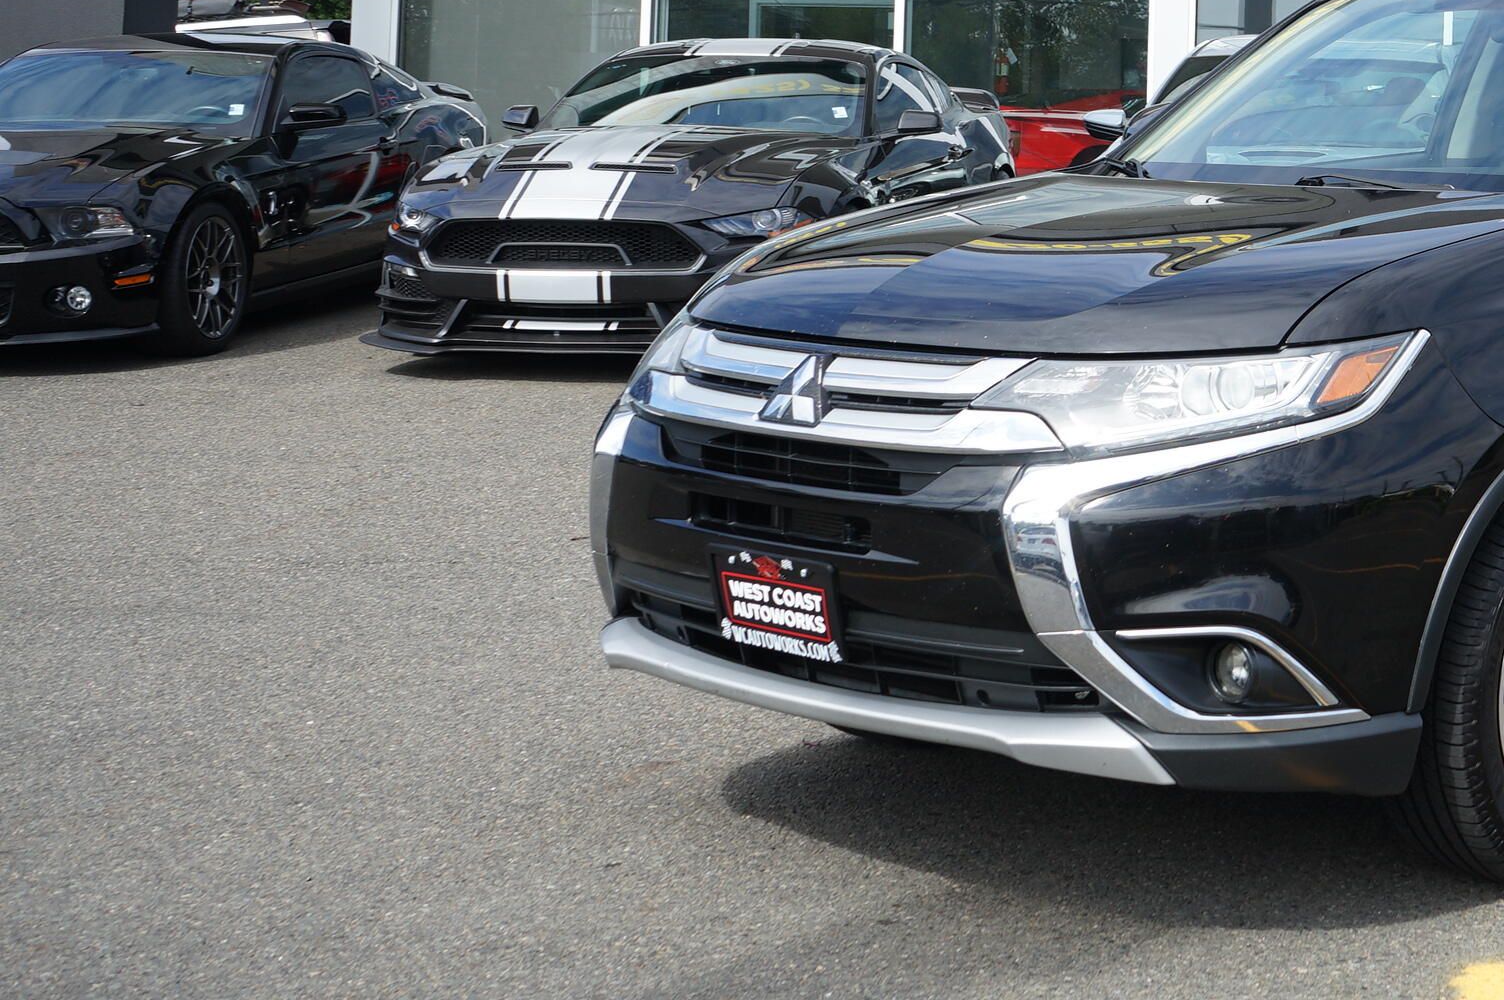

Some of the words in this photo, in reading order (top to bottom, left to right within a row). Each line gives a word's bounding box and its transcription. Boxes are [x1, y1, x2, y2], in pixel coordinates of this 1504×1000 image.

[728, 580, 771, 603] WEST
[772, 587, 822, 612] COAST
[733, 600, 827, 634] AUTOWORKS
[731, 625, 830, 662] WCAUTOWORKS.COM
